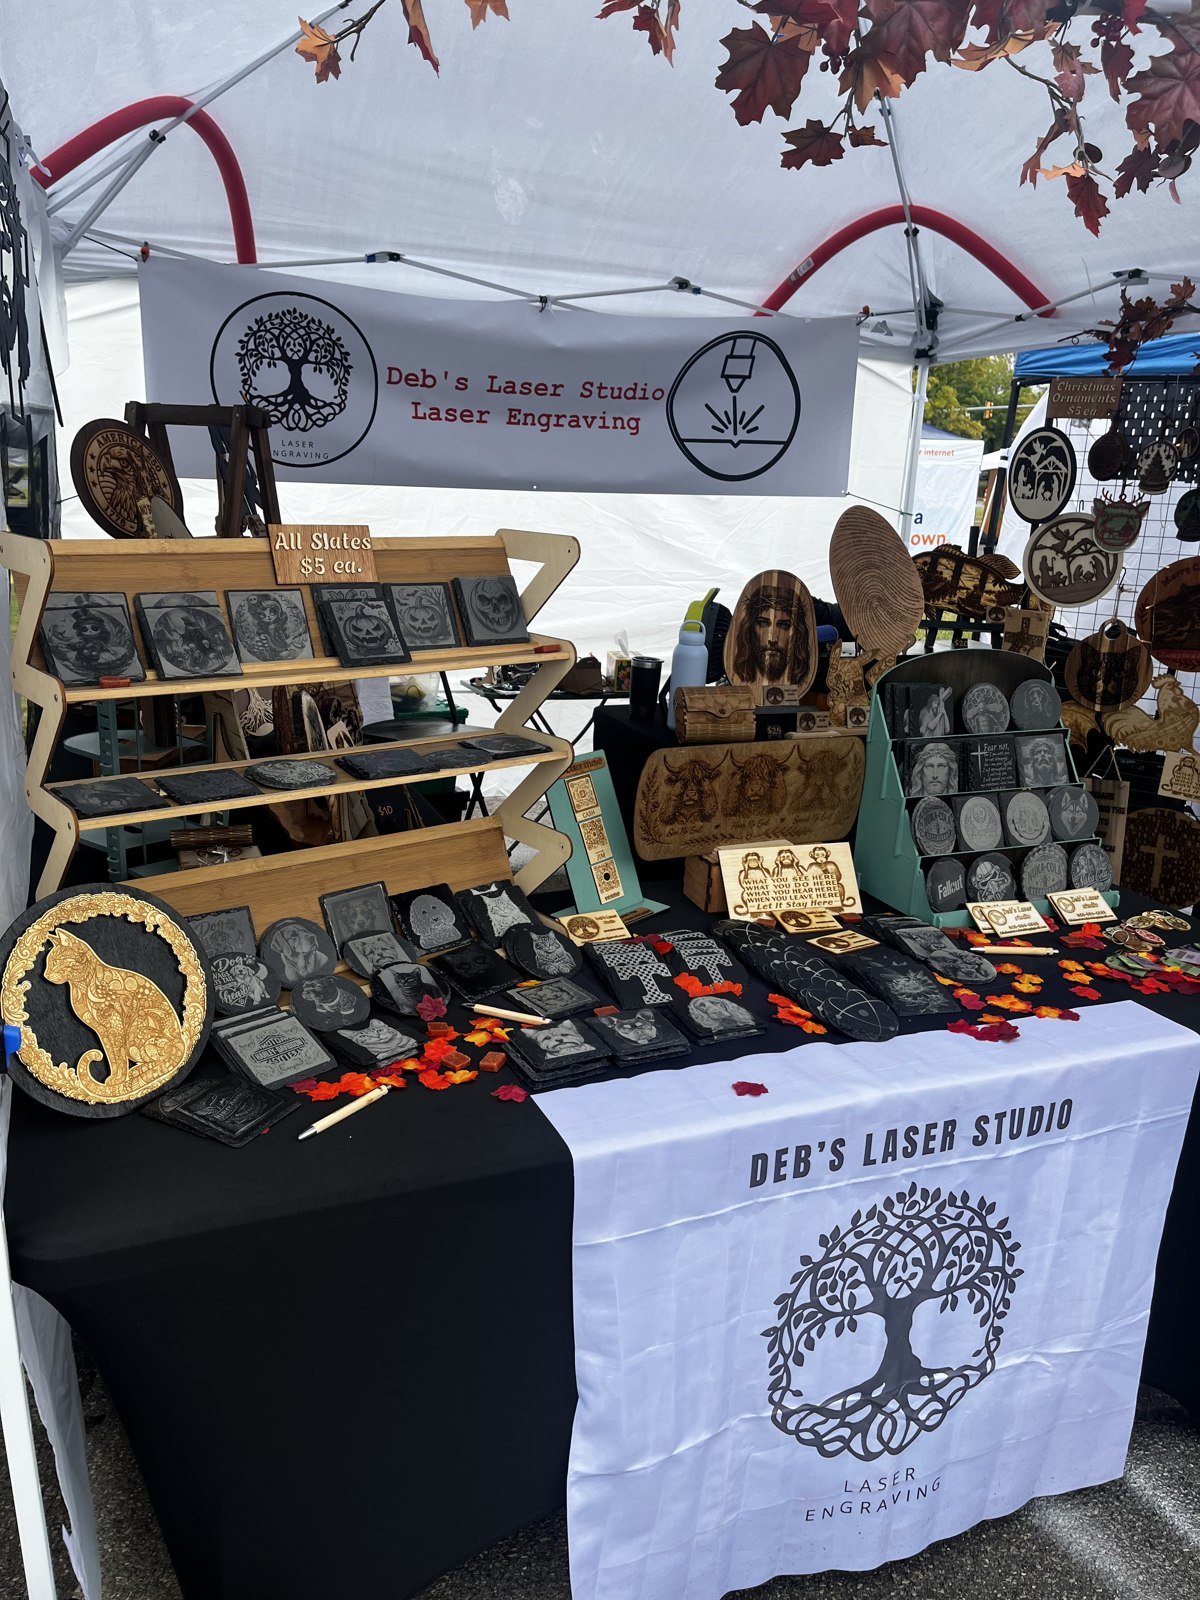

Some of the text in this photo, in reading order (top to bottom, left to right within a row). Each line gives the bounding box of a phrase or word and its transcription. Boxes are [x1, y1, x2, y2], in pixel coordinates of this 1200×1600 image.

[386, 367, 665, 401] Deb's Laser Studio
[1057, 381, 1116, 392] Christmas
[1052, 393, 1116, 403] Ornaments
[411, 401, 641, 435] Laser Engraving
[96, 432, 145, 454] AMERICA
[281, 440, 314, 448] LASER
[272, 449, 329, 460] NGRAVING
[924, 448, 955, 456] internet
[275, 532, 371, 550] All Slates
[300, 555, 362, 577] $5 ea.
[767, 726, 782, 735] $25
[983, 743, 997, 752] Fear
[377, 805, 394, 816] $10
[582, 809, 596, 819] CASH
[771, 876, 788, 884] YOU
[812, 873, 836, 881] HERE
[794, 881, 809, 889] DO
[937, 874, 963, 901] Fallout
[789, 893, 813, 901] LEAVE
[816, 891, 839, 899] HERE
[785, 901, 808, 909] Stay
[213, 956, 243, 973] Dog
[862, 1118, 957, 1167] LASER
[971, 1098, 1074, 1147] STUDIO
[844, 1467, 915, 1493] LASER
[805, 1476, 941, 1522] ENGRAVING
